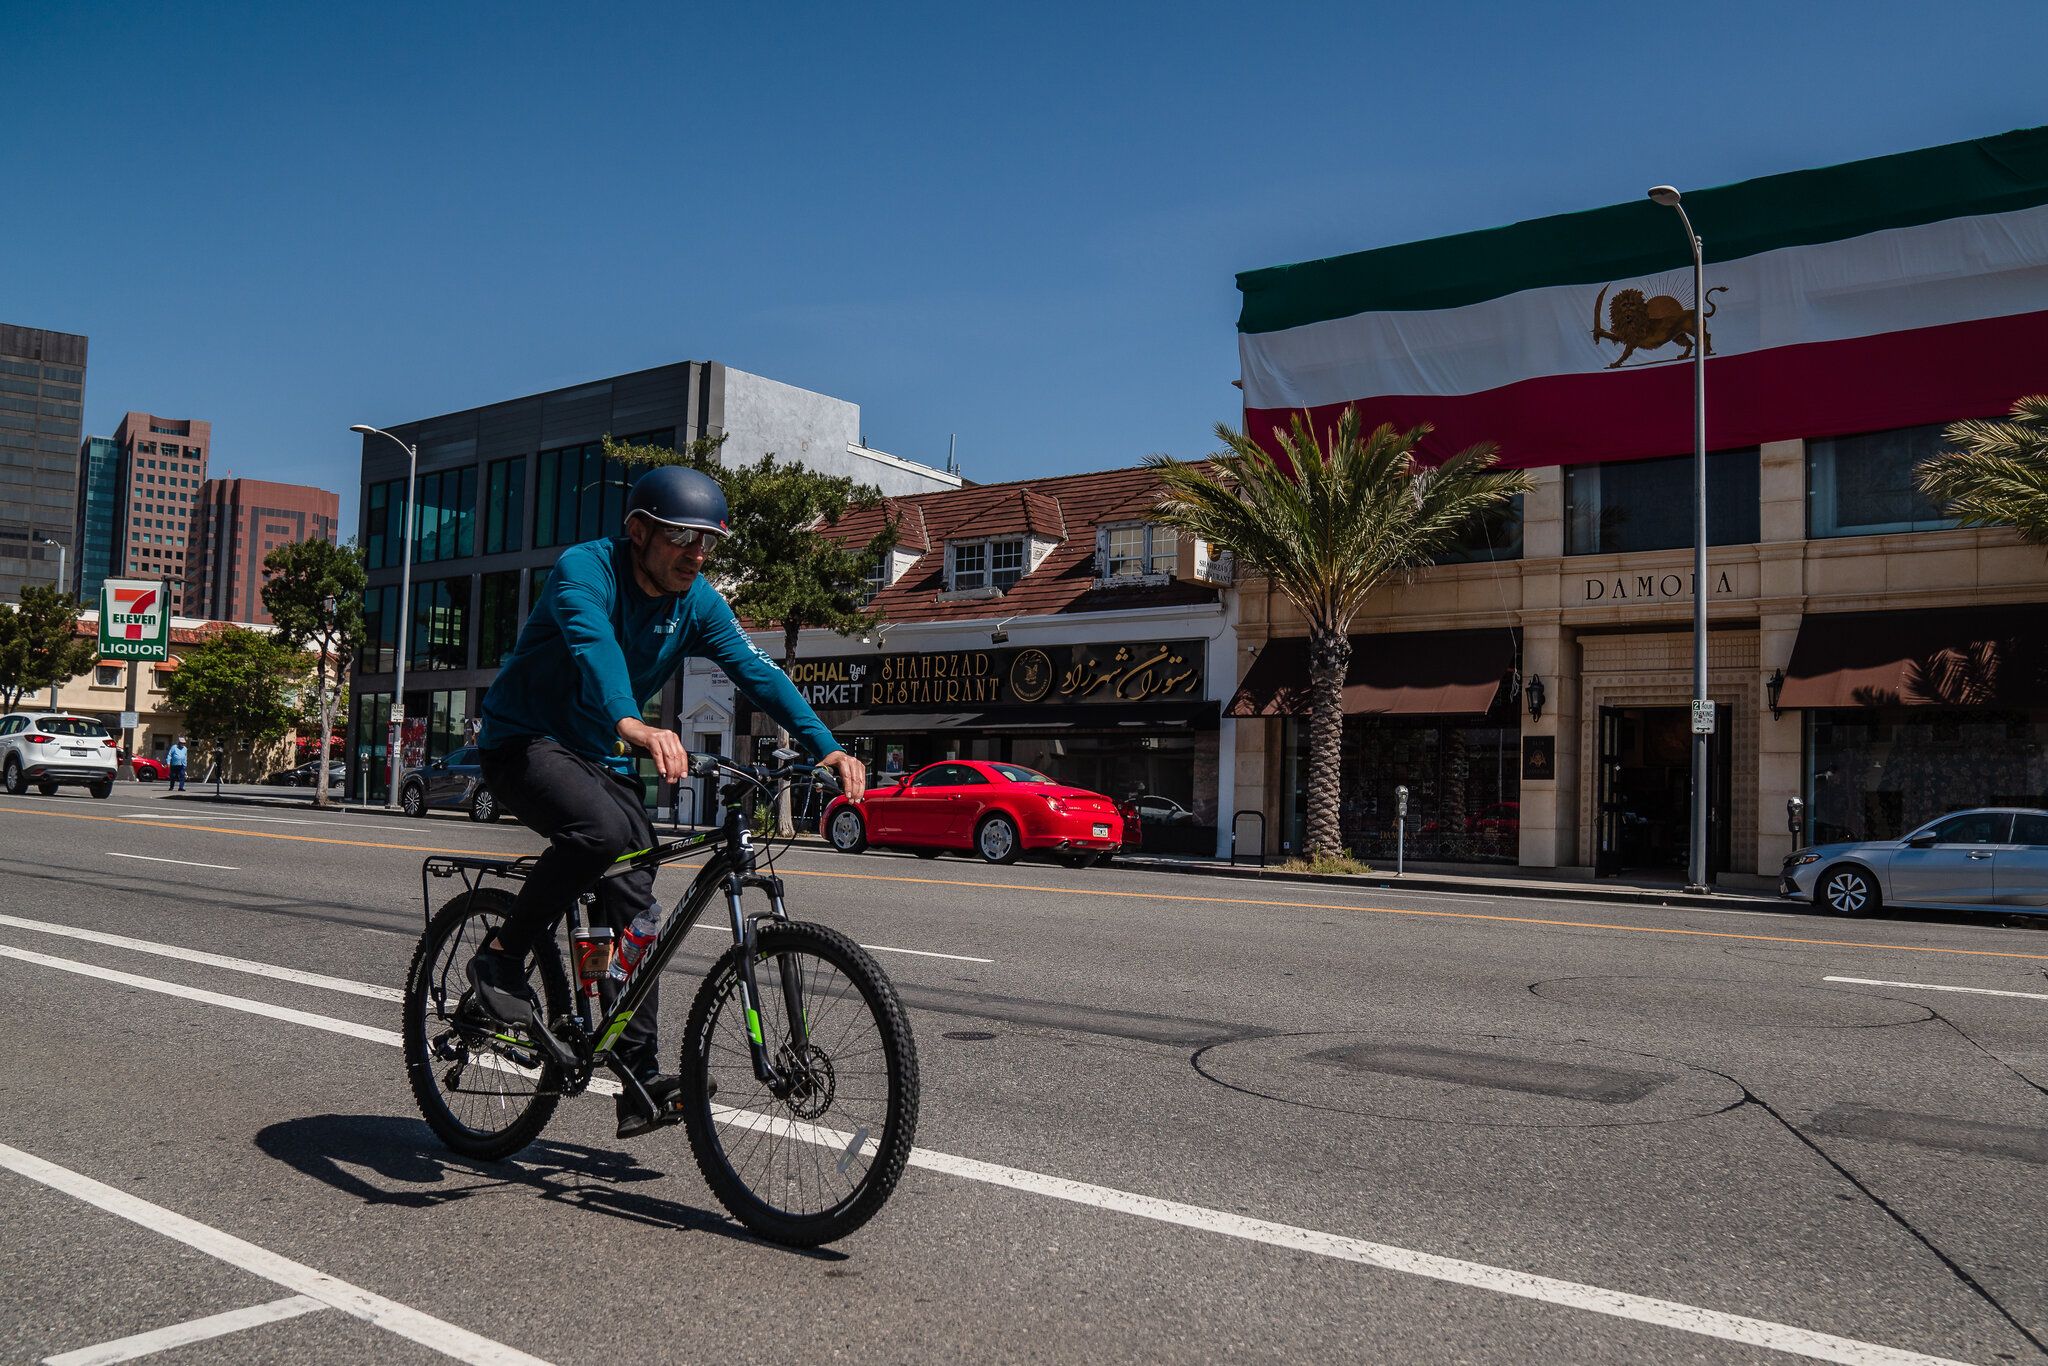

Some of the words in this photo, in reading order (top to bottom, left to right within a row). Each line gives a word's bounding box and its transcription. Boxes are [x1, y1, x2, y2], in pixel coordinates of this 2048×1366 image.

[114, 588, 156, 640] 7
[100, 643, 164, 656] LIQUOR
[783, 662, 849, 682] OCHAL
[849, 664, 867, 675] Deli
[881, 653, 989, 680] SHAHRZAD
[797, 684, 863, 704] ARKET
[871, 678, 999, 704] RESTAURANT
[1694, 702, 1700, 710] 2
